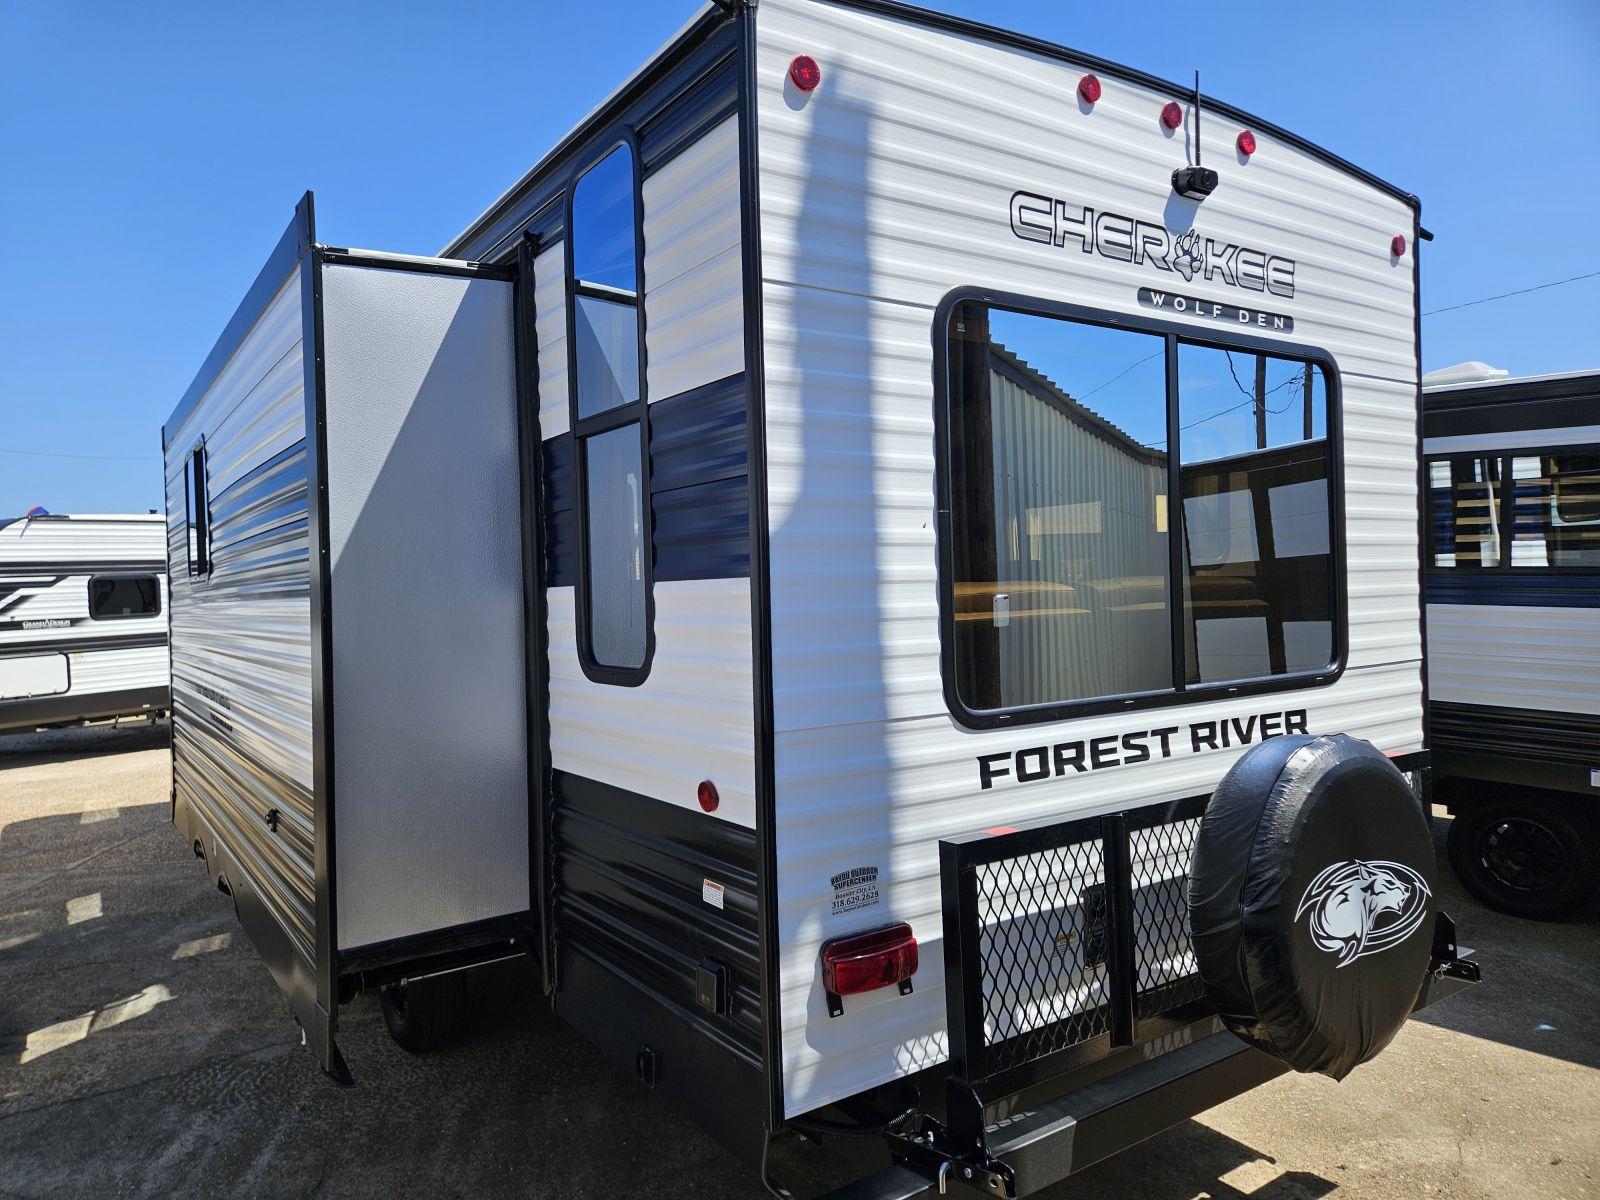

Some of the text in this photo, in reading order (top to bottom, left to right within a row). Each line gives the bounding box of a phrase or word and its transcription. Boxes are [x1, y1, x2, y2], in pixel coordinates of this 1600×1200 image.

[1150, 291, 1285, 330] WOLF DEN
[976, 708, 1310, 790] FOREST RIVER
[831, 870, 850, 885] BAYOU
[833, 874, 877, 891] SUPERCENTER
[831, 890, 879, 909] 318.629.2628
